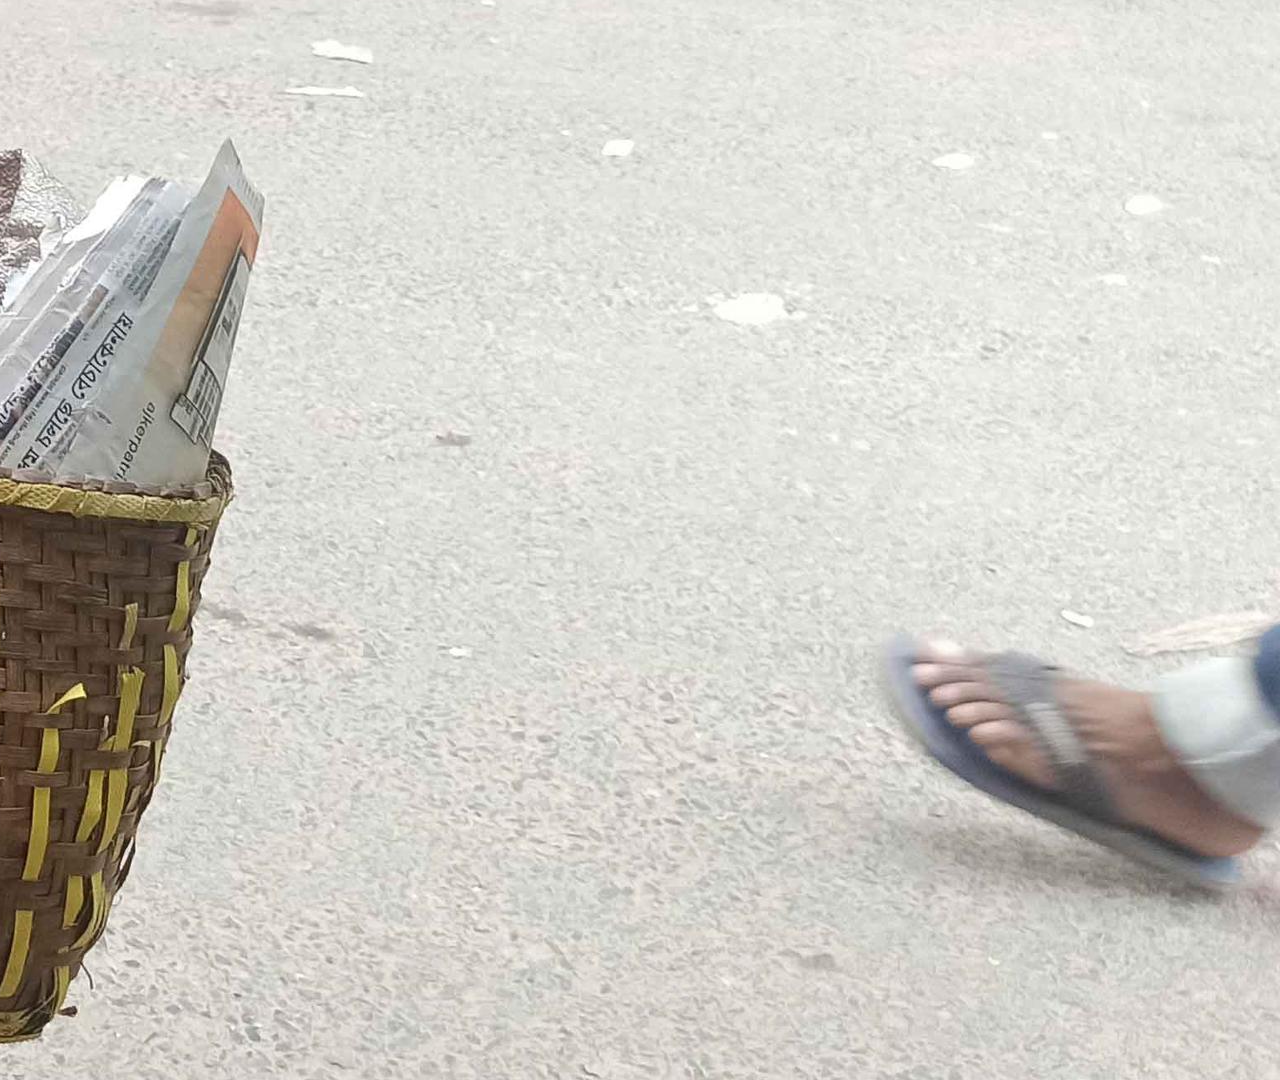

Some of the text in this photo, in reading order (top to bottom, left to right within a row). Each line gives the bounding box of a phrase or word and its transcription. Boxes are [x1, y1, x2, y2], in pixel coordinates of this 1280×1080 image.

[35, 396, 75, 449] চলছে
[70, 311, 135, 400] বেচাকেনায়
[113, 401, 156, 481] ajkerpatri
